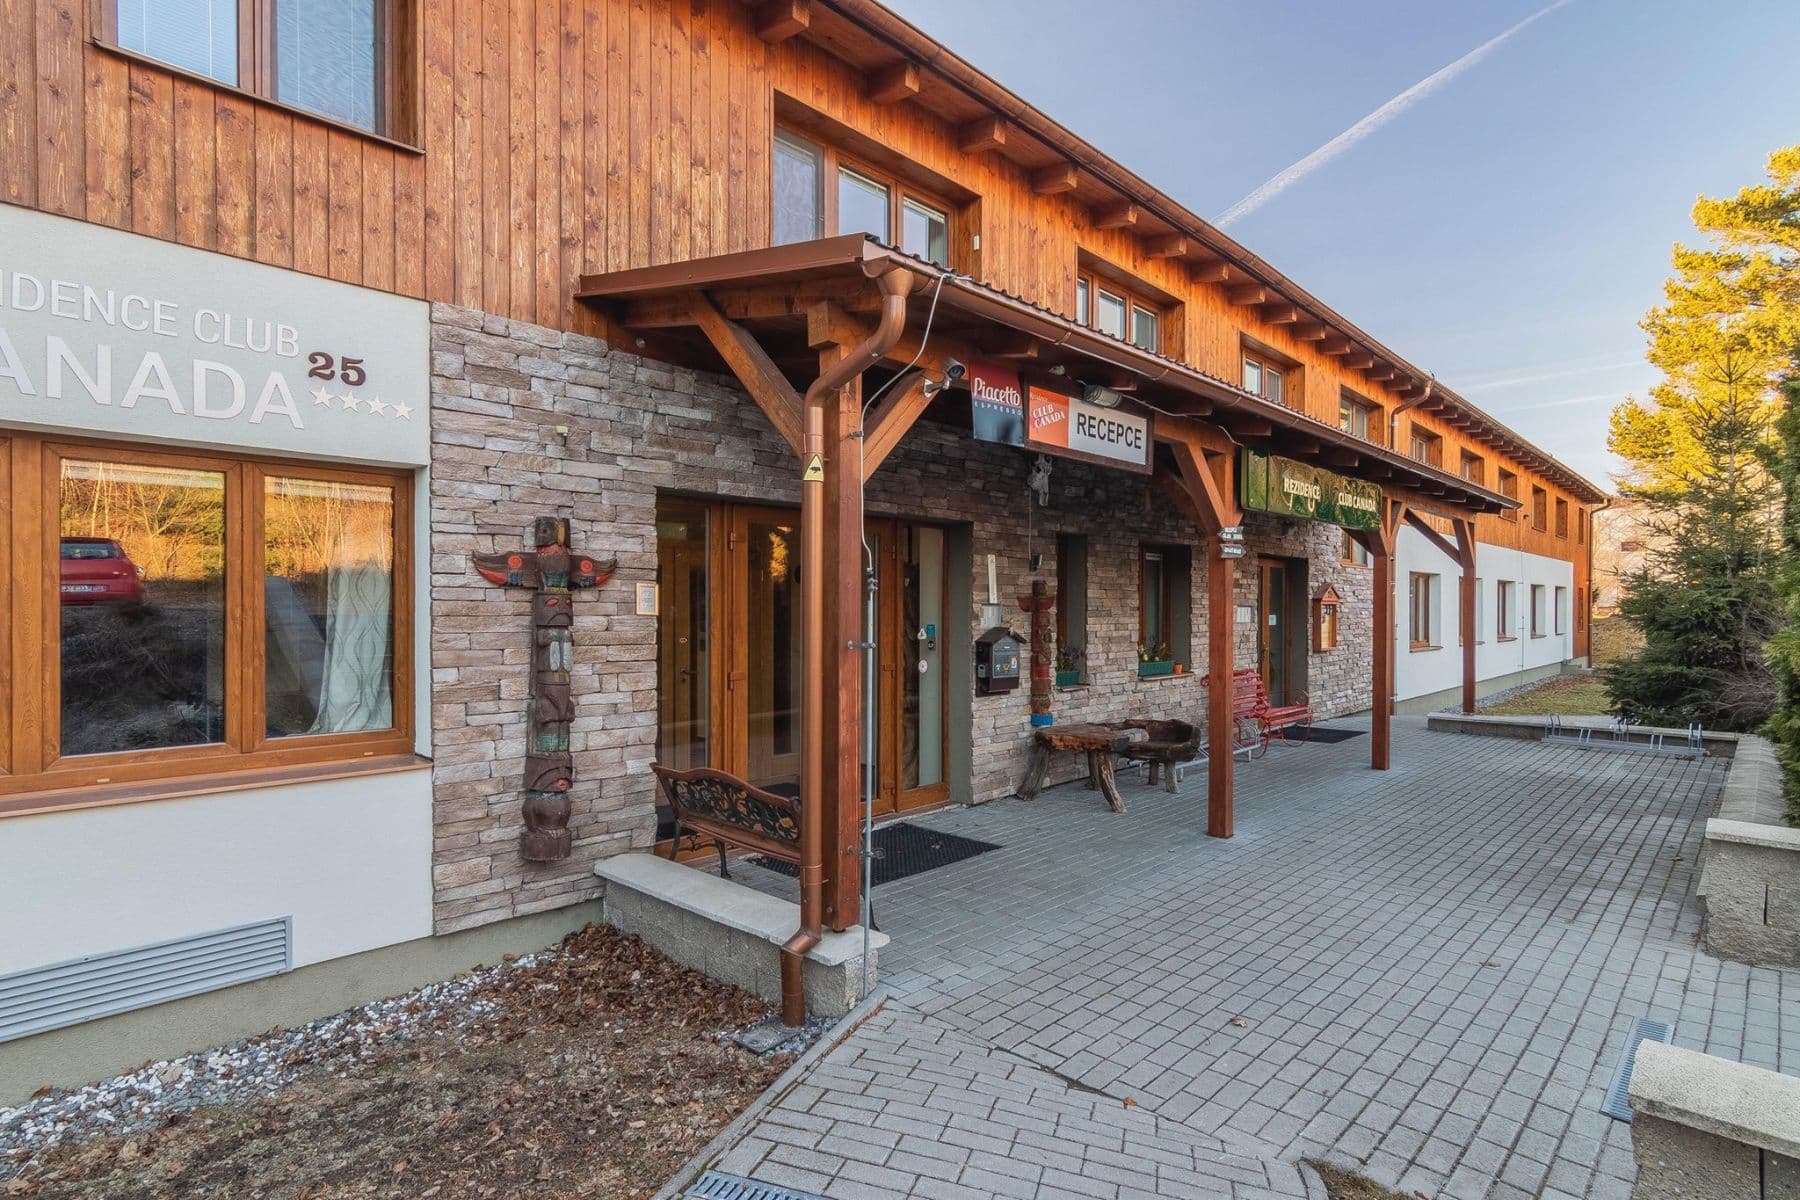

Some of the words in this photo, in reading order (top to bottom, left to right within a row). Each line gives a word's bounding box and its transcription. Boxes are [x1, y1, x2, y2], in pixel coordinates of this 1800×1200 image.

[192, 308, 300, 358] CLUB
[307, 351, 367, 386] 25
[974, 377, 1021, 406] Piacetto
[1032, 403, 1055, 419] CLUB
[1034, 411, 1066, 429] CANADA
[1077, 412, 1142, 450] RECEPCE
[1283, 477, 1321, 500] REZIDENCE
